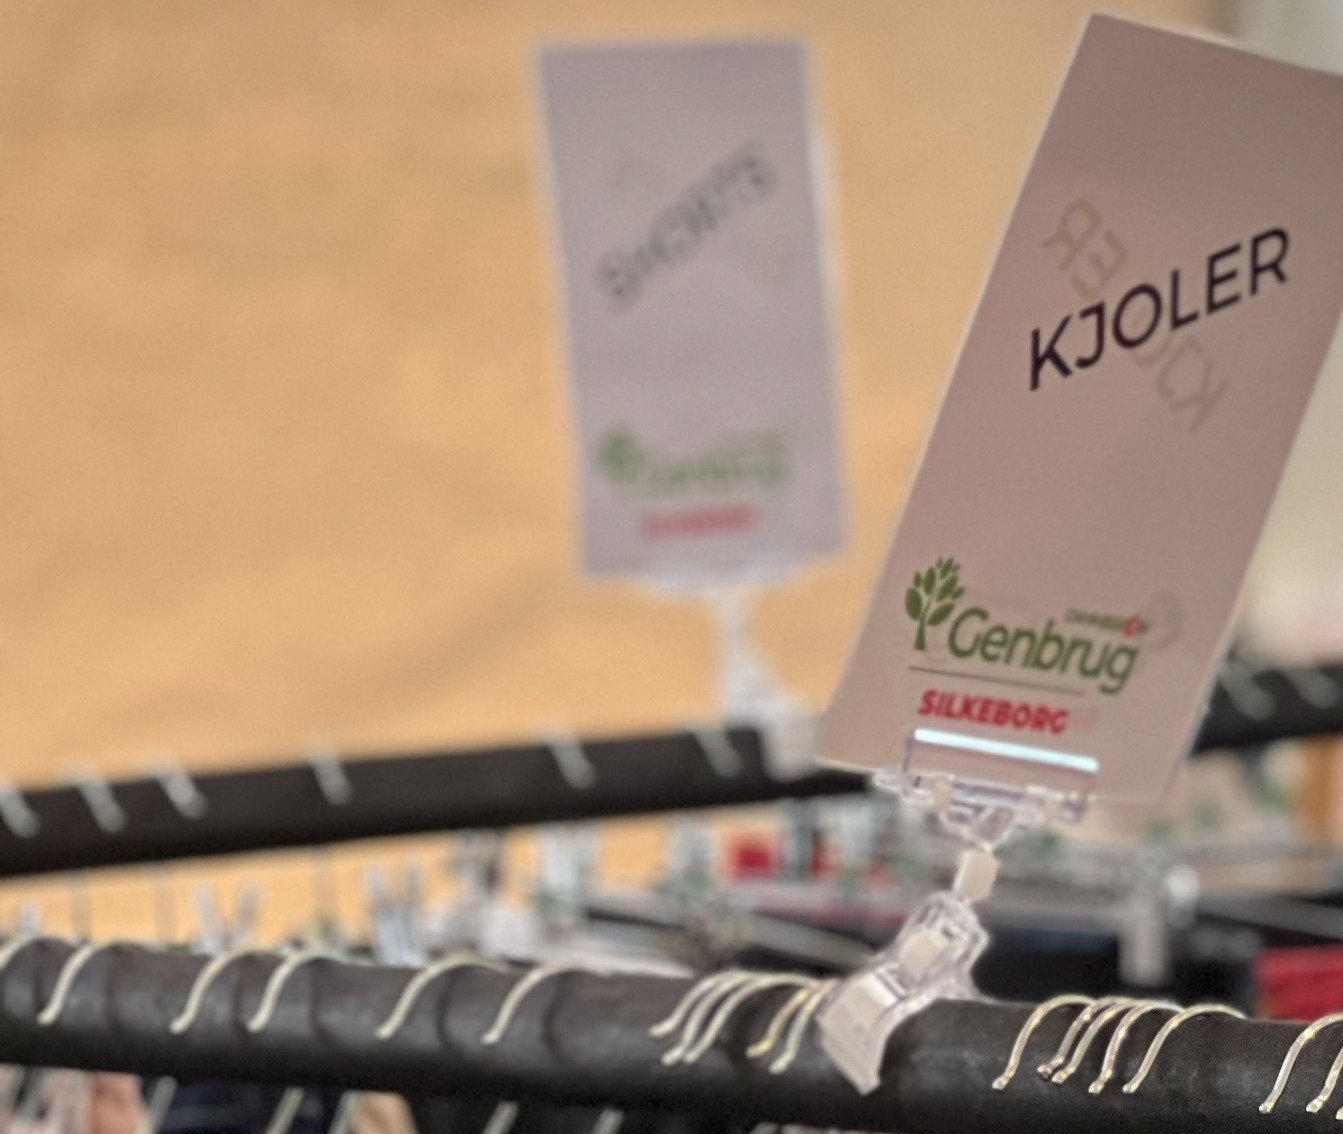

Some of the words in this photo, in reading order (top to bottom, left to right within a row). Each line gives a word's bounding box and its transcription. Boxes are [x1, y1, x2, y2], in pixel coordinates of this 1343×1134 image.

[1030, 226, 1290, 391] KJOLER
[948, 607, 1139, 694] Genbrug
[918, 690, 1070, 734] SILKEBORG
